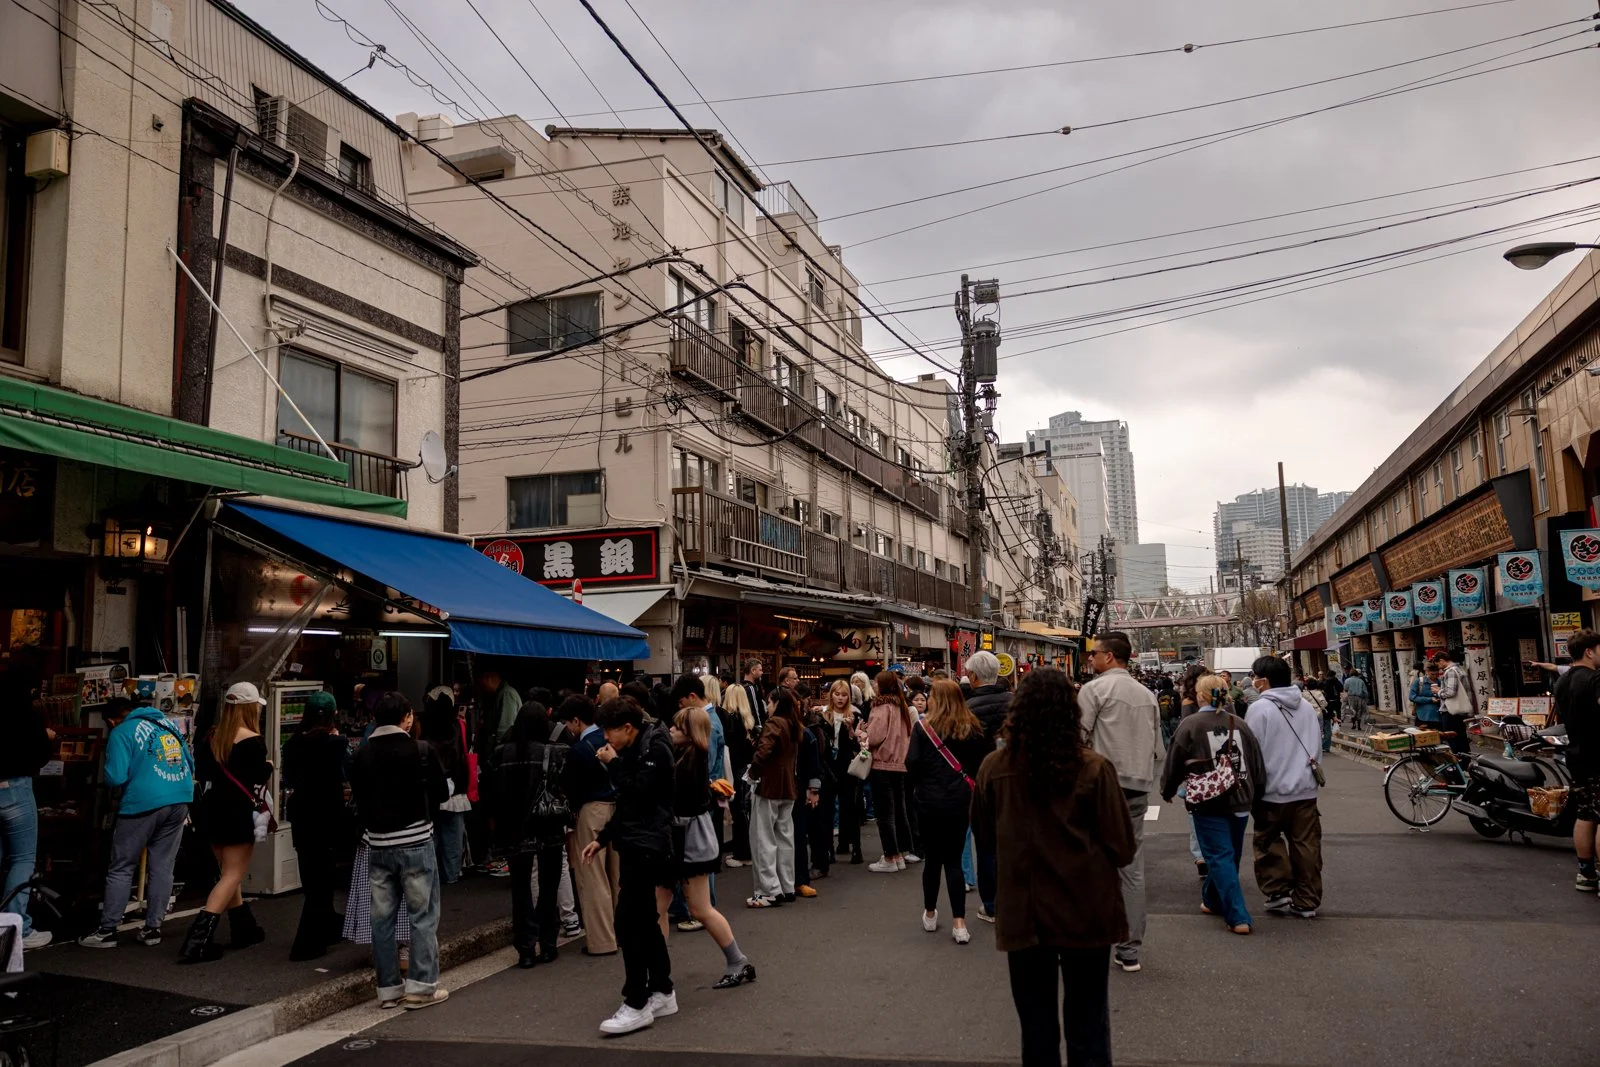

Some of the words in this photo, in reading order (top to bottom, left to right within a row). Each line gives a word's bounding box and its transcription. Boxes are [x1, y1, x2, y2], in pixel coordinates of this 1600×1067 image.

[611, 184, 633, 456] 築地センタービル
[542, 537, 635, 580] 黒銀
[1473, 656, 1489, 711] 中原水産
[135, 720, 155, 751] STAY
